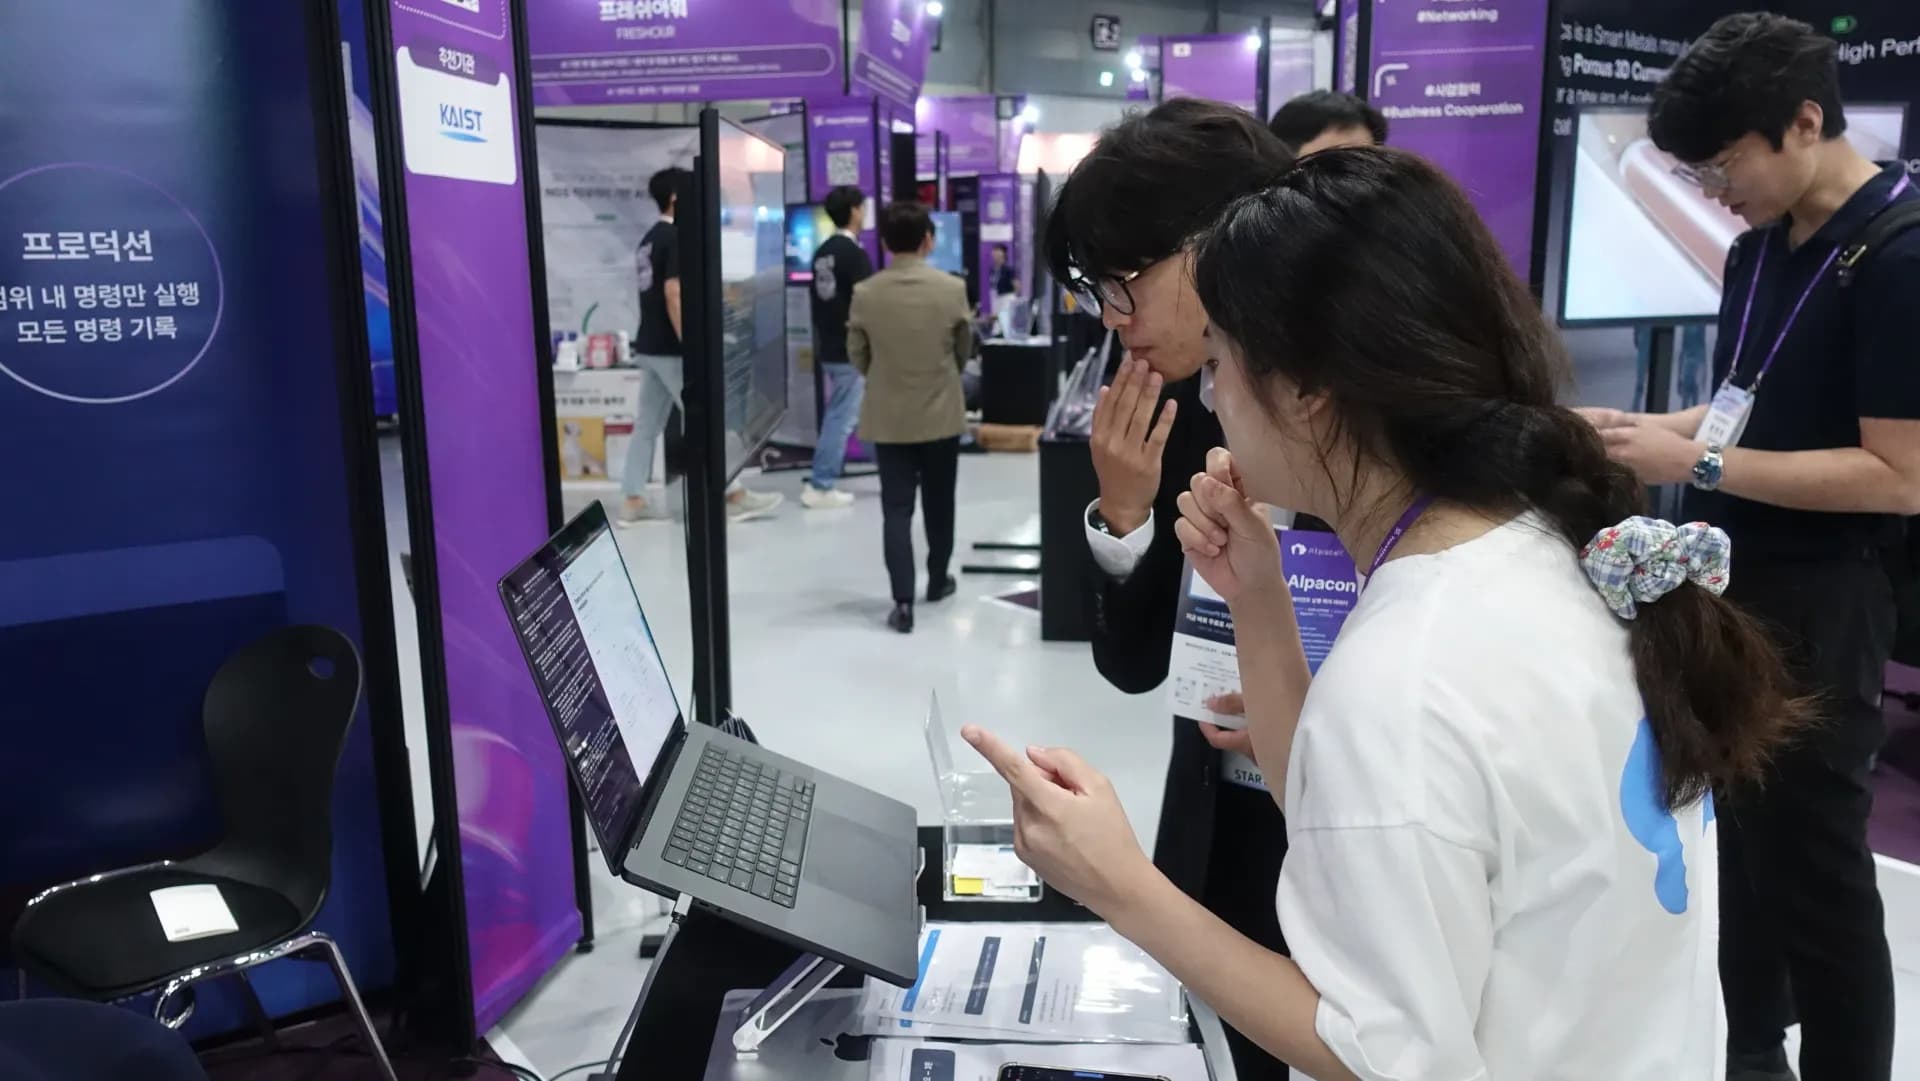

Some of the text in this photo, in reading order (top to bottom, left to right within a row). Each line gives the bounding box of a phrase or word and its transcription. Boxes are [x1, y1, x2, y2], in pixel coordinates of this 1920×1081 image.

[1417, 8, 1499, 23] #Networking
[1594, 23, 1624, 47] Smart
[1573, 52, 1613, 78] Porous
[1614, 58, 1631, 80] 3D
[439, 103, 482, 131] KAIST
[1382, 101, 1524, 118] #Business Cooperation
[22, 229, 154, 262] 프로덕션
[41, 284, 67, 310] 내
[73, 283, 147, 309] 명령만
[153, 281, 200, 307] 실행
[17, 316, 178, 344] 모든 명령 기록
[1288, 574, 1356, 593] Alpacon
